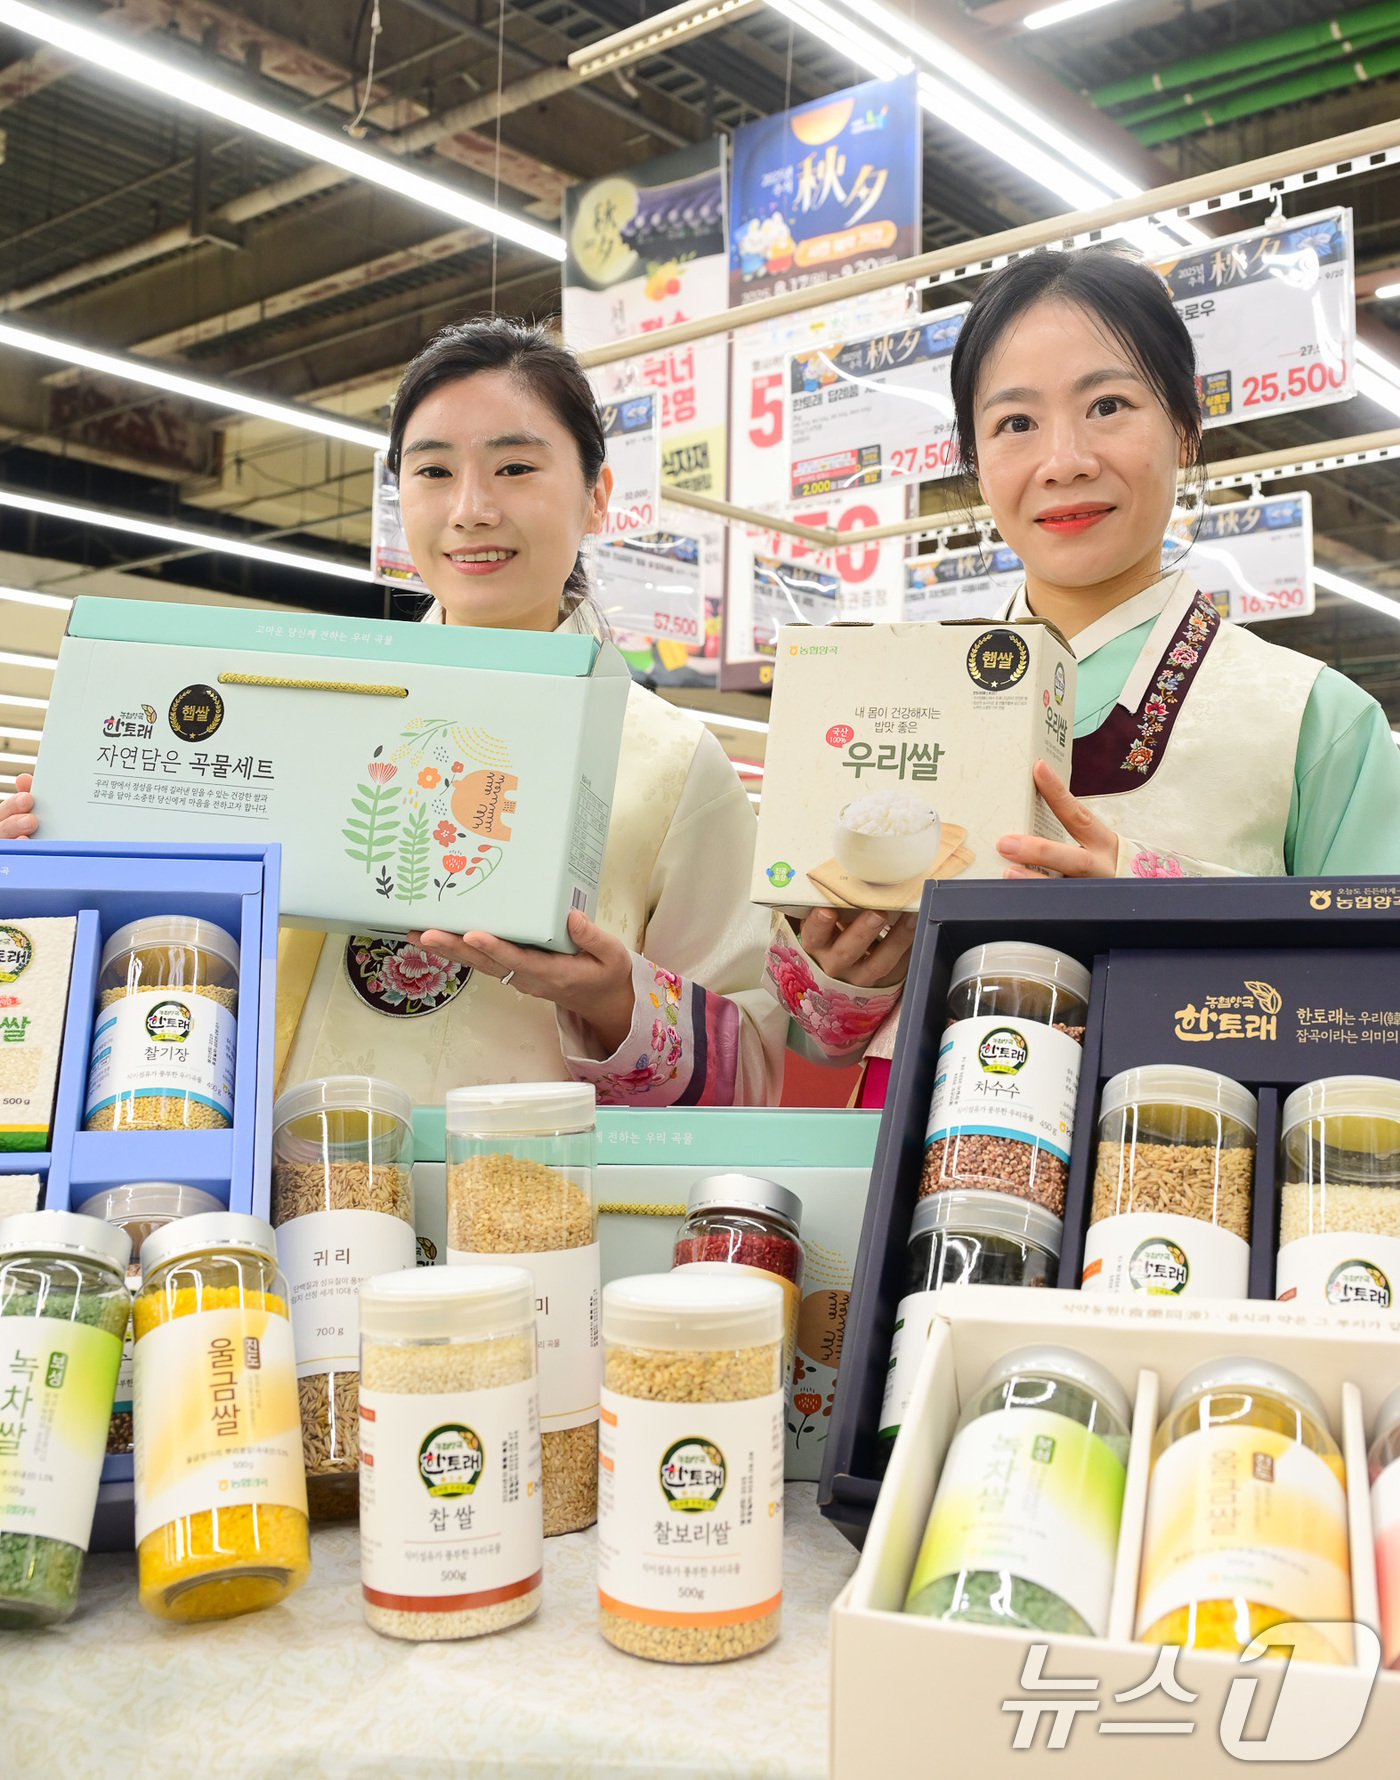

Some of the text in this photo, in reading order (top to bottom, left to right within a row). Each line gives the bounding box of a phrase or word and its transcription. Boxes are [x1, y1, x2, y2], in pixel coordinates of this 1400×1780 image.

[792, 144, 889, 228] 秋夕
[1209, 237, 1281, 288] 秋夕
[865, 328, 921, 370] 秋夕
[1242, 359, 1346, 407] 25,500
[792, 392, 824, 412] 한토래
[1215, 506, 1262, 536] 秋夕
[1240, 588, 1304, 614] 16,900
[653, 611, 699, 637] 57,500
[255, 625, 394, 646] 고마운 당신께 전하는 우리 곡물
[800, 645, 839, 656] 농협양곡
[982, 650, 1014, 670] 햅쌀
[182, 704, 210, 722] 햅쌀
[854, 706, 942, 720] 내 몸이 건강해지는
[103, 716, 154, 740] 한토래
[831, 727, 849, 738] 국산
[874, 720, 918, 734] 밥맛 좋은
[96, 744, 275, 780] 자연담은 곡물세트
[842, 742, 946, 782] 우리쌀
[95, 779, 109, 790] 우리
[110, 780, 131, 791] 땅에서
[132, 782, 153, 793] 정성을
[153, 783, 169, 794] 다해
[206, 788, 214, 799] 수
[215, 789, 230, 800] 있는
[231, 790, 253, 803] 건강한
[253, 792, 268, 803] 쌀과
[92, 790, 268, 814] 잡곡을 담아 소중한 당신에게 마음을 전하고자 합니다.
[1337, 887, 1362, 896] 오늘도
[1205, 995, 1255, 1009] 농협양곡
[147, 1015, 191, 1030] 한토래
[1174, 1003, 1277, 1042] 한토래
[1296, 1007, 1357, 1027] 한토래는
[1296, 1028, 1400, 1045] 잡곡이라는 의미의
[144, 1045, 190, 1063] 찰기장
[981, 1043, 1026, 1062] 한토래
[973, 1079, 1021, 1100] 차수수
[2, 1097, 23, 1105] 500
[607, 1130, 694, 1146] 전하는 우리 곡물
[319, 1288, 334, 1297] 세계
[335, 1286, 352, 1296] 10대
[320, 1277, 349, 1288] 섬유질이
[316, 1326, 344, 1337] 700 g
[245, 1337, 261, 1369] 진도
[47, 1353, 66, 1387] 보성
[207, 1337, 241, 1437] 울금쌀
[423, 1451, 480, 1475] 한토래
[664, 1464, 724, 1488] 한토래
[653, 1521, 732, 1547] 찰보리쌀
[440, 1569, 467, 1583] 500g
[677, 1586, 705, 1600] 500g
